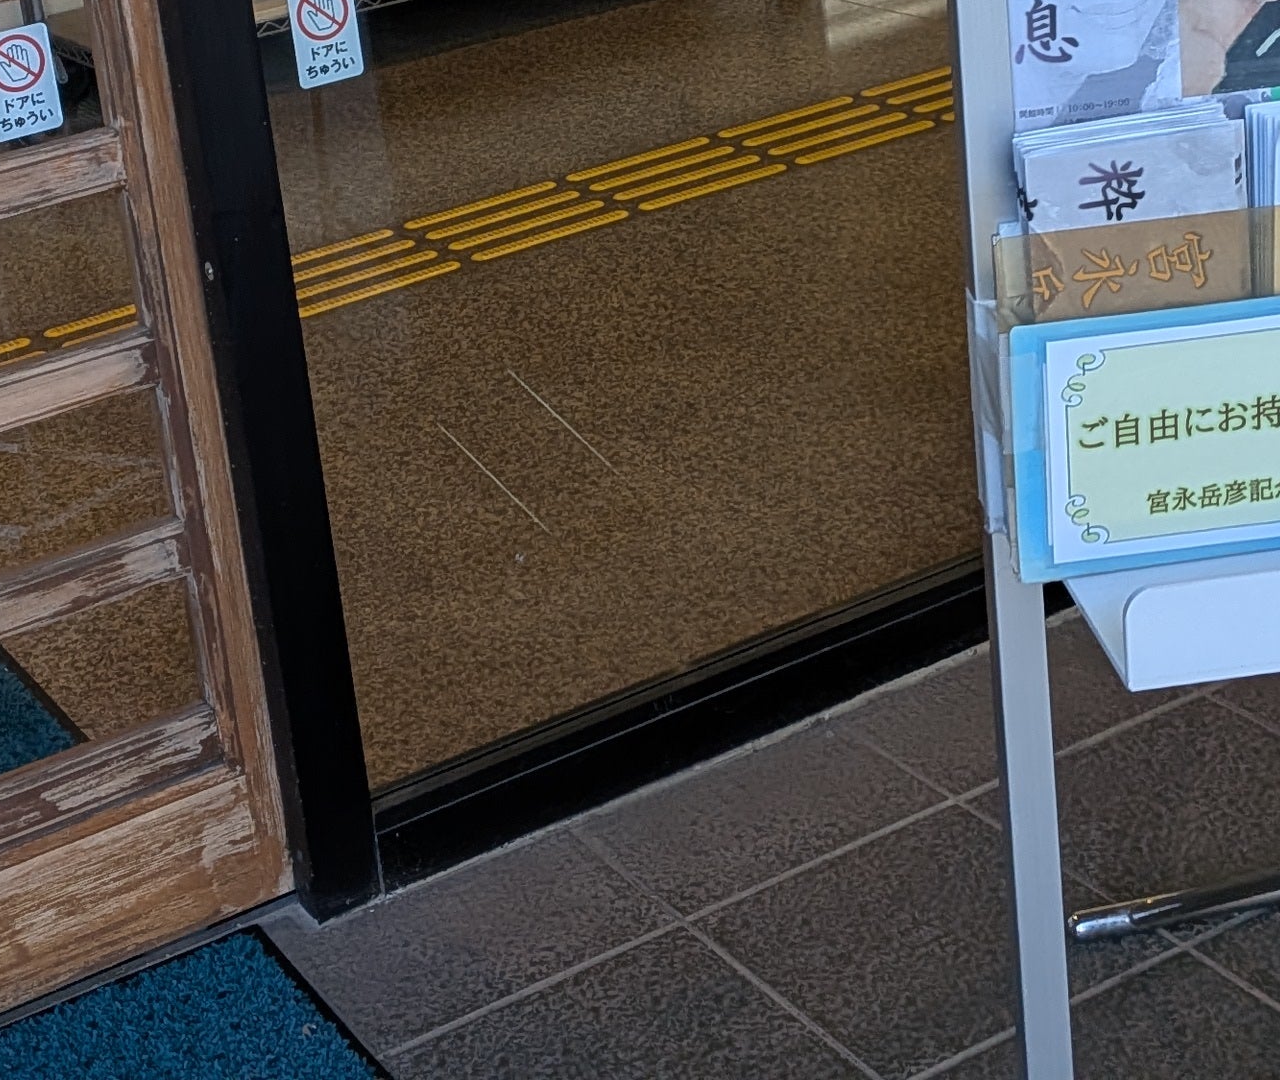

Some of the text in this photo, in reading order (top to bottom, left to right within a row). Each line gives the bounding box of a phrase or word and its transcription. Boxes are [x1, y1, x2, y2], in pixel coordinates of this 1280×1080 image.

[309, 40, 349, 63] ドアに
[305, 55, 356, 81] ちゅうい
[3, 91, 46, 114] ドアに
[0, 106, 55, 133] ちゅうい
